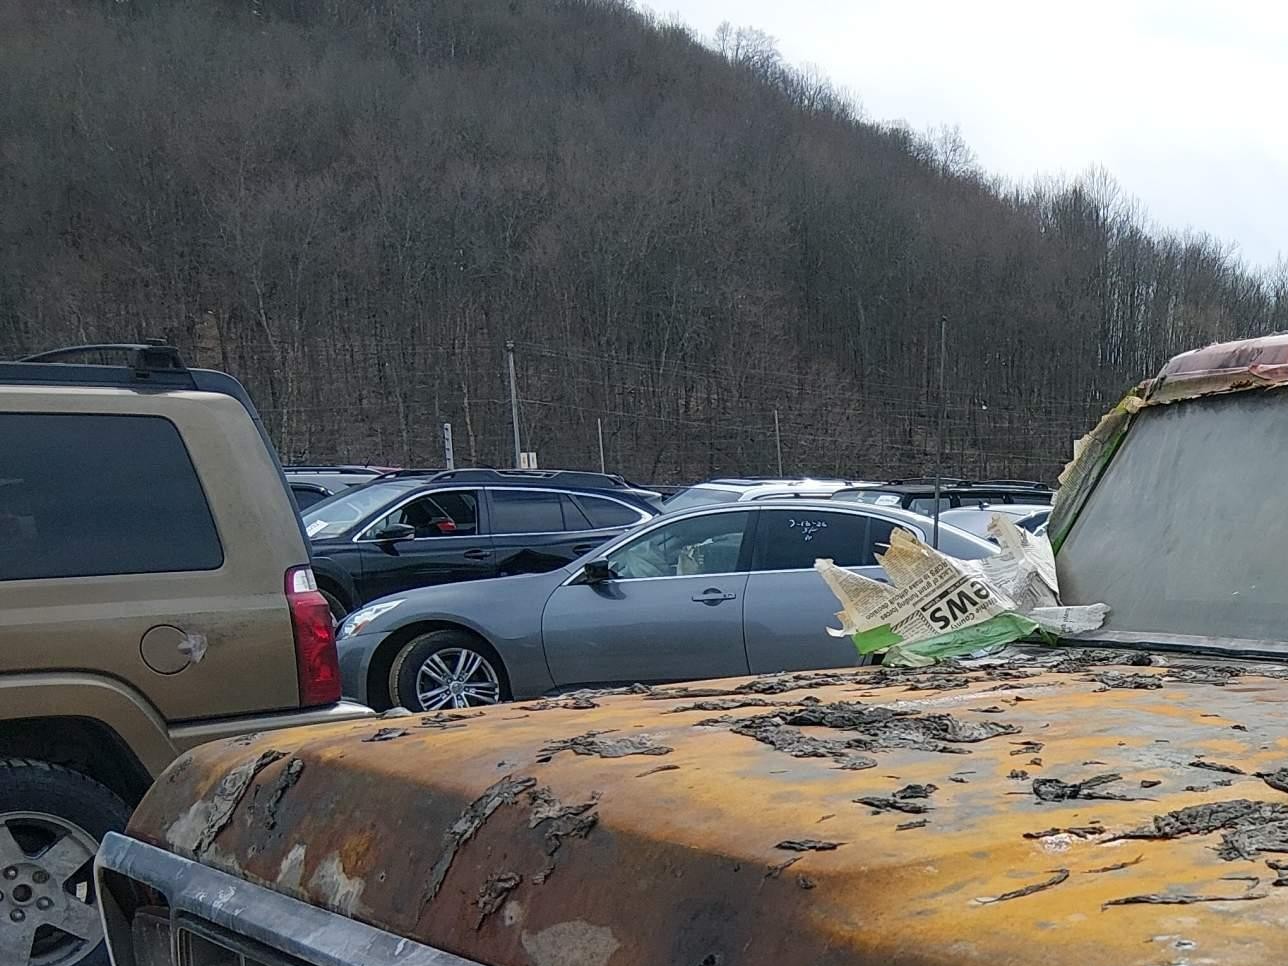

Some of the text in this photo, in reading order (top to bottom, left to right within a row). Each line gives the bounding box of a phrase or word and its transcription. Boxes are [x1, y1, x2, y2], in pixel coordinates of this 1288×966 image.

[939, 567, 954, 582] Lack
[908, 576, 924, 591] make
[917, 580, 935, 596] grant
[888, 586, 909, 604] difficult
[897, 588, 919, 607] funding
[864, 599, 890, 620] decision
[879, 604, 900, 621] forces
[949, 612, 977, 631] County
